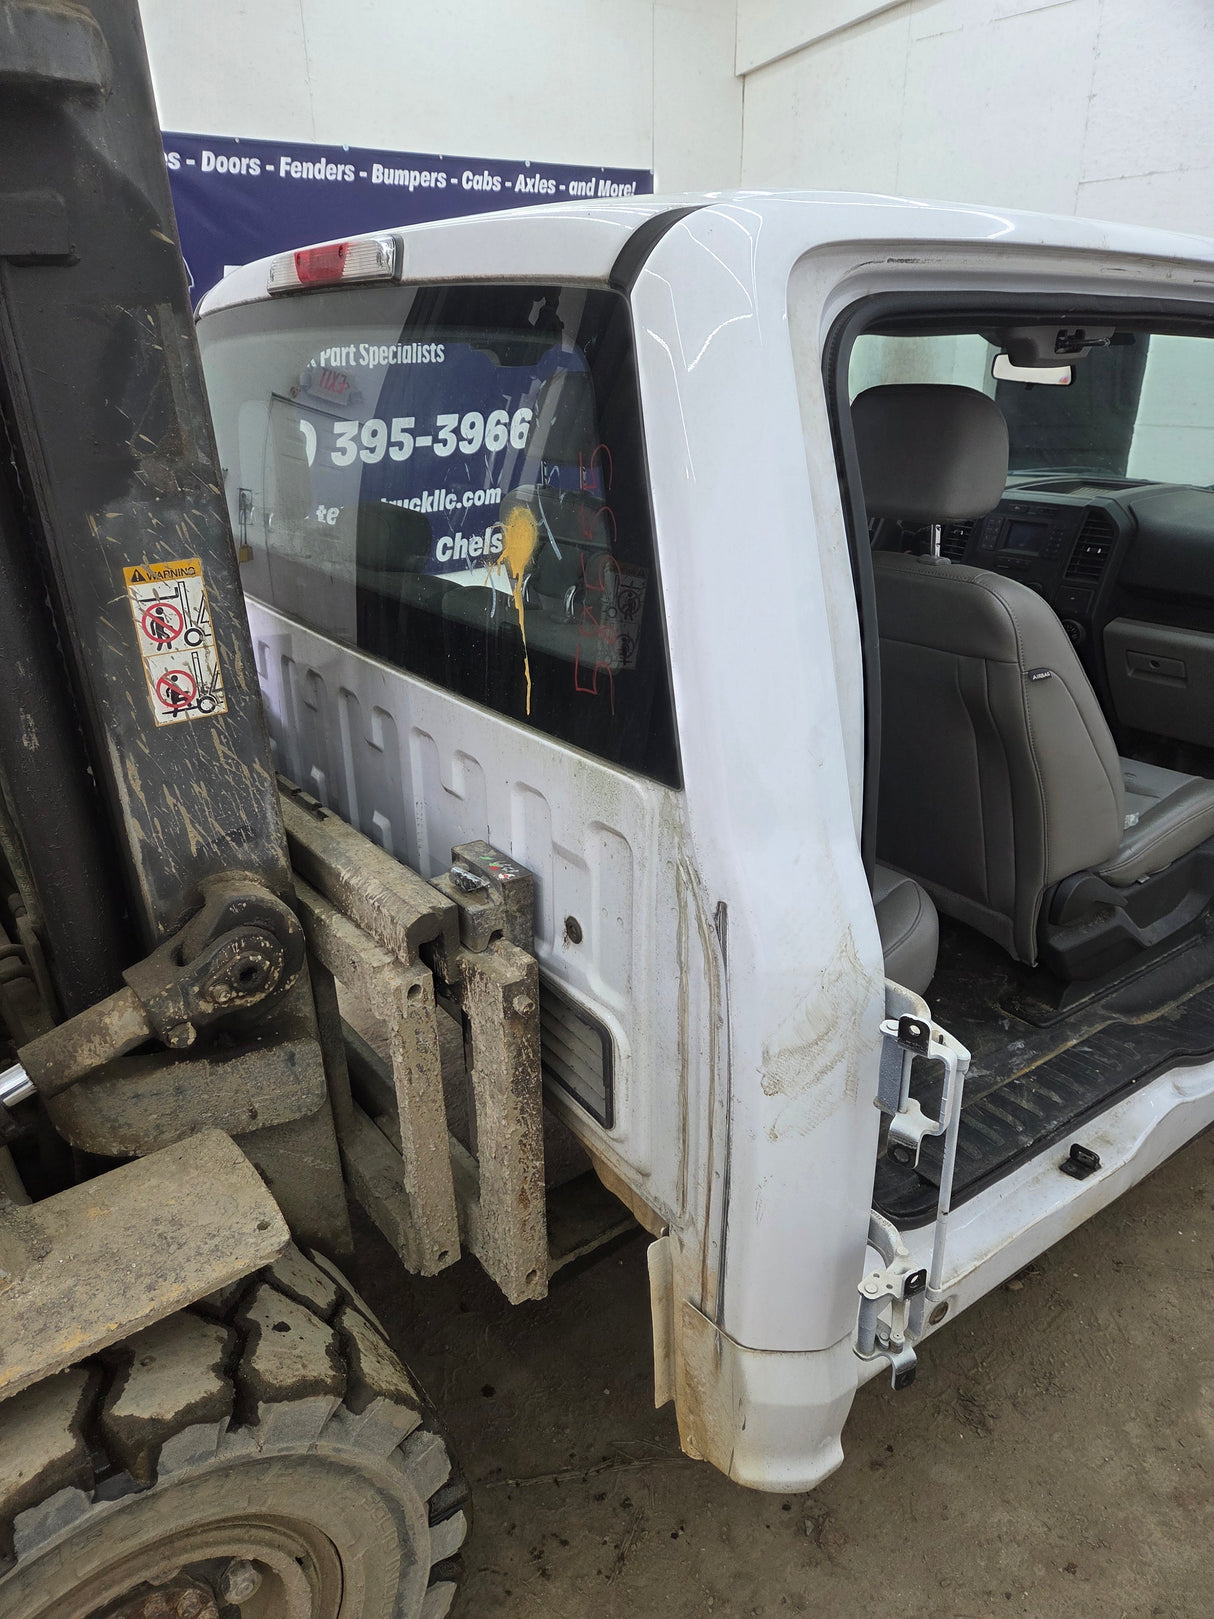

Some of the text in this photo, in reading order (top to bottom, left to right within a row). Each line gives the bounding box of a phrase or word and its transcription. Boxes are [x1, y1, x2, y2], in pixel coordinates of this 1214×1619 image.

[163, 151, 181, 170] s
[201, 150, 261, 175] Doors
[279, 156, 355, 181] Fenders
[371, 163, 447, 191] Bumpers
[461, 170, 501, 191] Cabs
[514, 174, 556, 194] Axles
[568, 178, 596, 197] and
[598, 179, 637, 197] More!
[359, 343, 445, 368] Specialists
[330, 407, 533, 467] 395-3966
[146, 566, 196, 581] WARNING
[1032, 671, 1051, 681] AIRBAG
